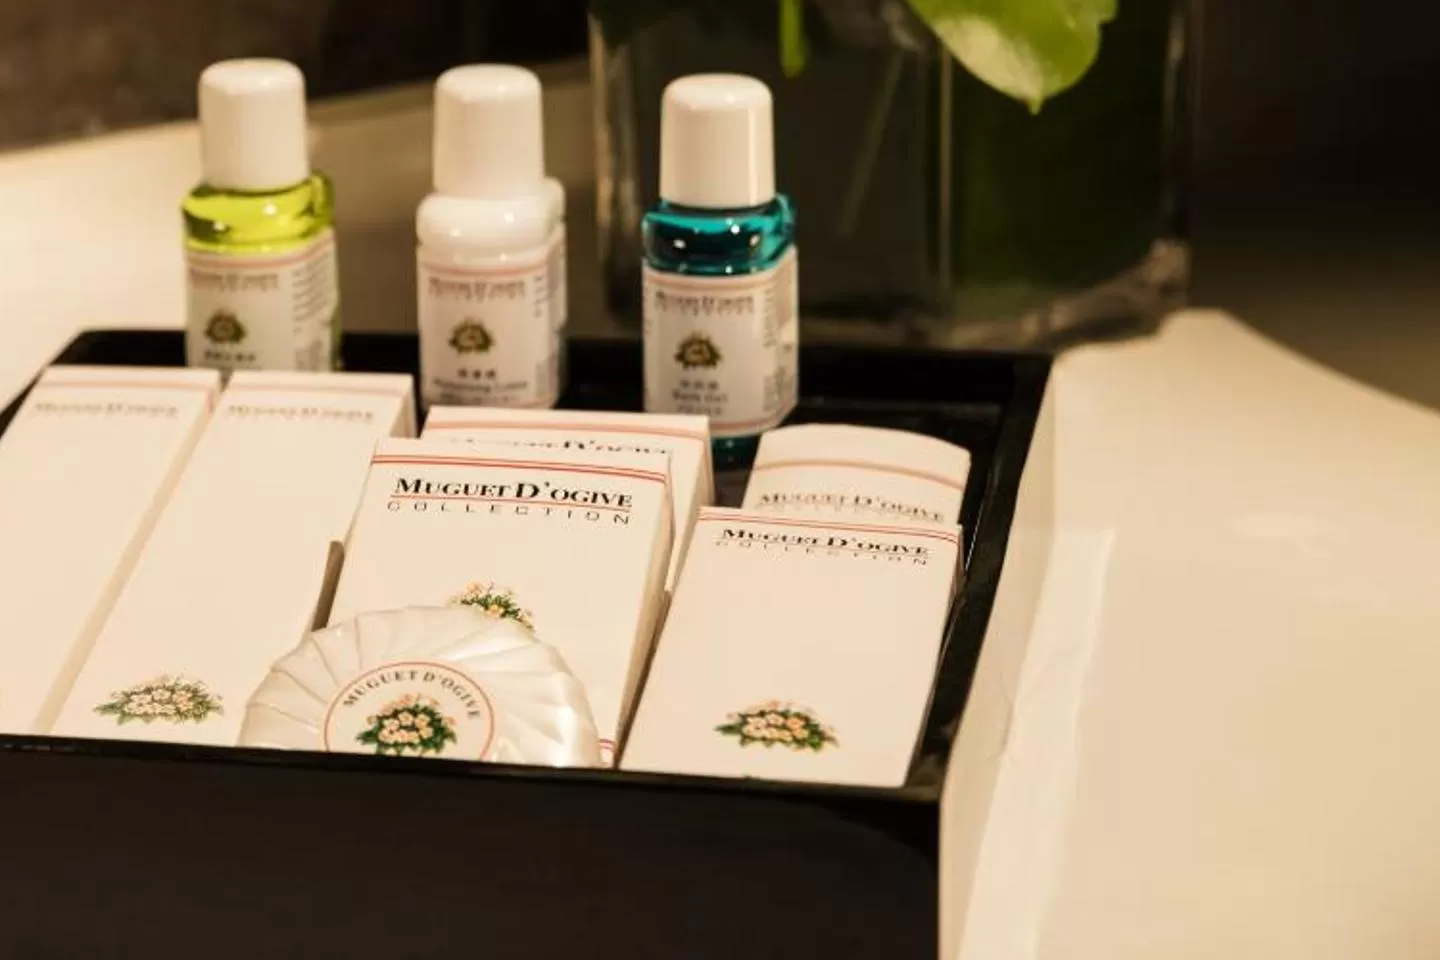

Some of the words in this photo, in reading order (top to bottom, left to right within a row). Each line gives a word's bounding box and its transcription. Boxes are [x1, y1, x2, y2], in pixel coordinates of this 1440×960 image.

[395, 478, 511, 498] MUGUET
[515, 480, 633, 508] D'OGIVE
[387, 500, 630, 525] COLLECTION
[723, 528, 821, 545] MUGUET
[343, 670, 418, 708] MUGUET
[423, 670, 481, 718] D'OGIVE
